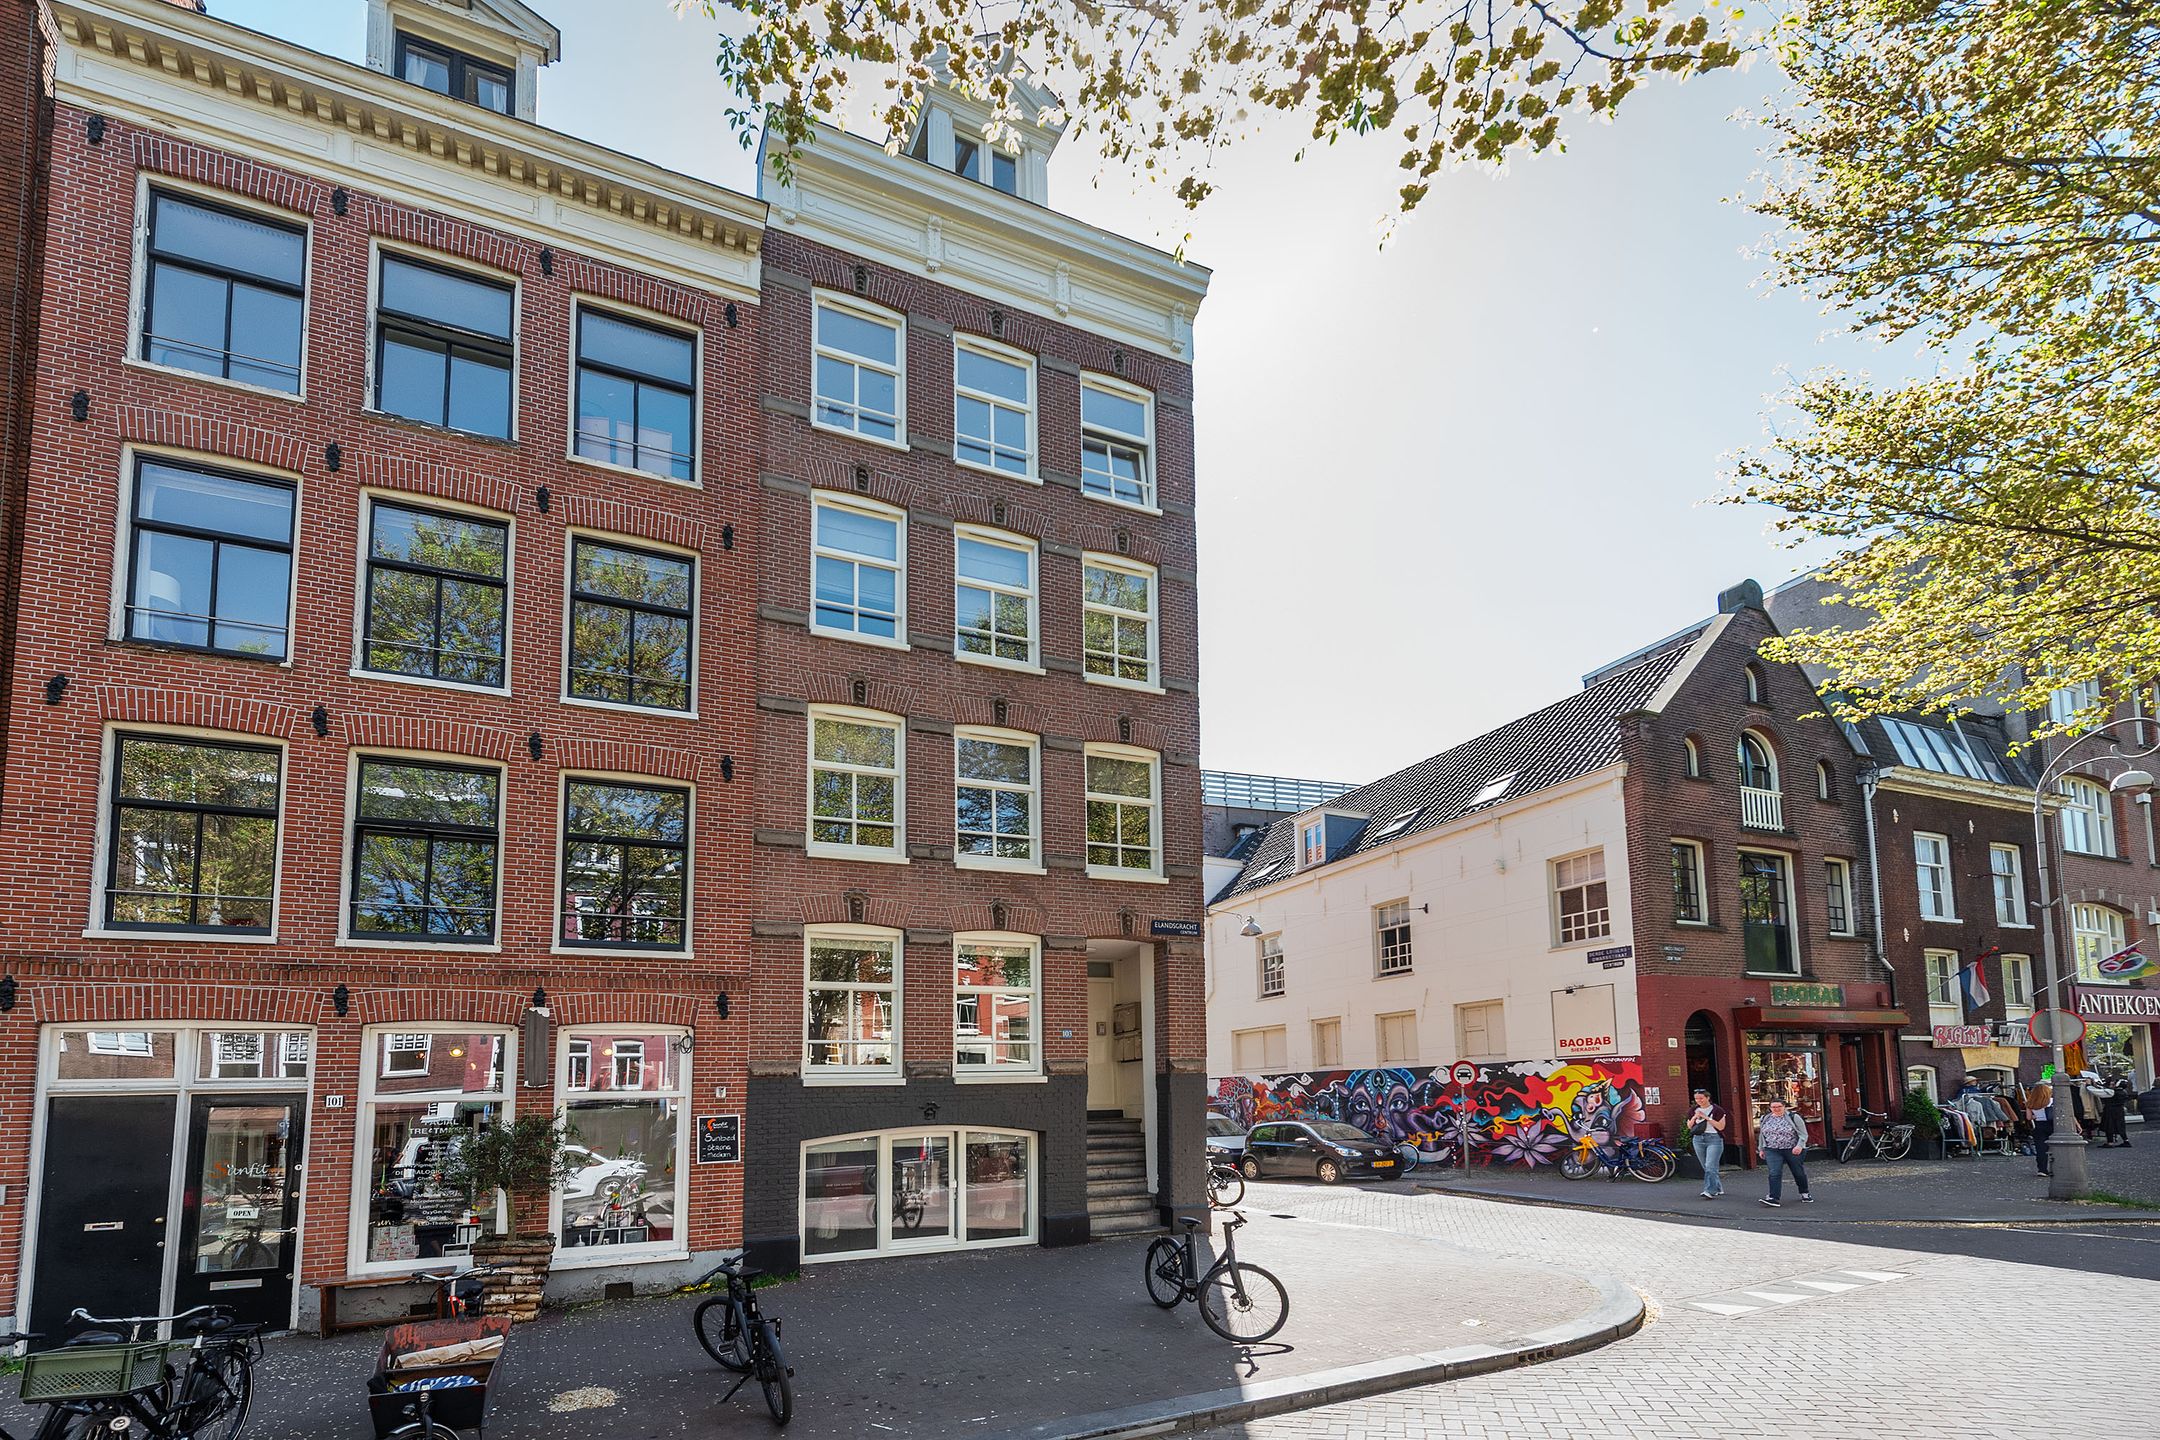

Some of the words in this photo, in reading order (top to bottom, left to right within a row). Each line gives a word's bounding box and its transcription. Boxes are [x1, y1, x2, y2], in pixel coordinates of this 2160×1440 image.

[1154, 921, 1198, 930] ELANDSGRACHT
[1062, 1030, 1072, 1038] 103
[1560, 1036, 1611, 1048] BAOBAB
[328, 1097, 341, 1106] 101
[704, 1133, 735, 1142] Sunbed
[208, 1160, 270, 1179] Sunfit
